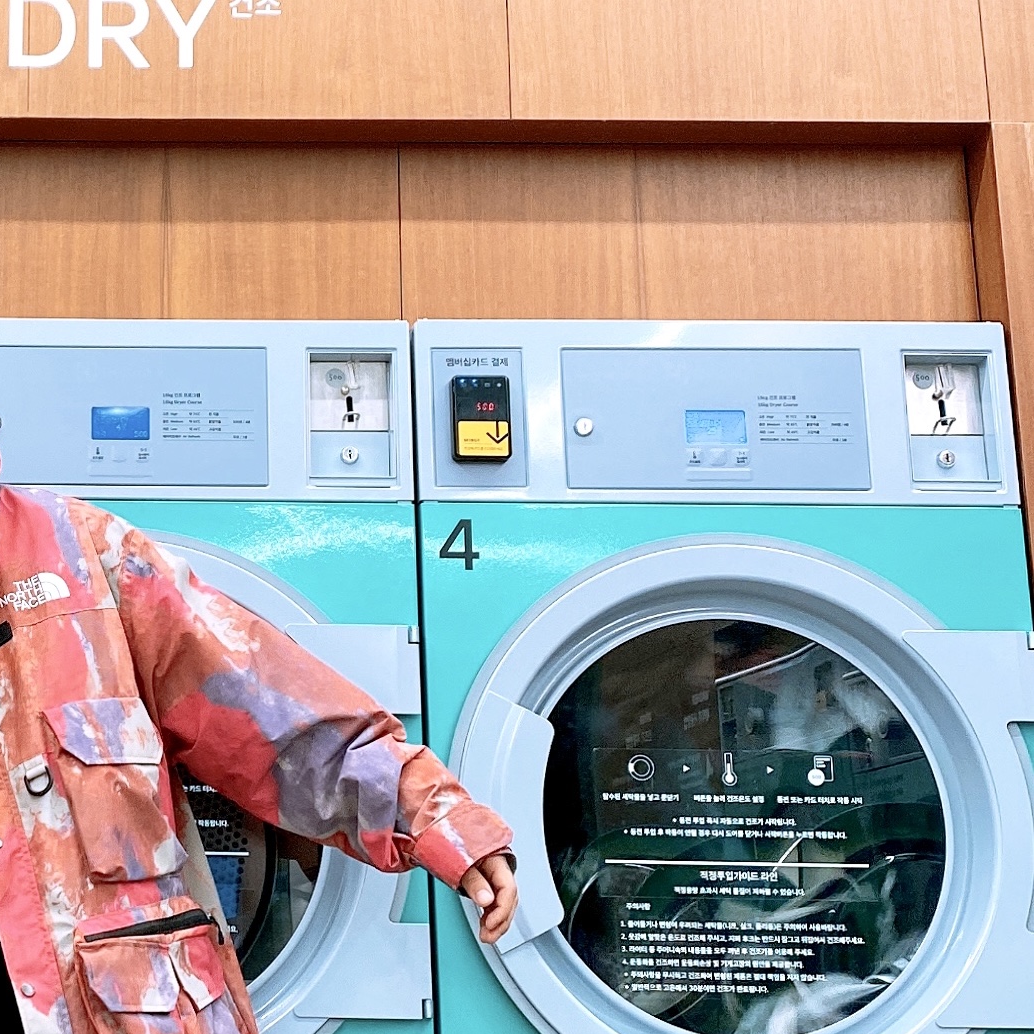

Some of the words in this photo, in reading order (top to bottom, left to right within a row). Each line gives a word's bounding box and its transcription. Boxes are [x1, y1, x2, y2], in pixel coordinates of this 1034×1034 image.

[8, 0, 215, 69] DRY
[446, 358, 488, 366] 멤버십카드
[492, 358, 509, 366] 결제
[477, 402, 495, 411] 500
[438, 518, 480, 572] 4
[13, 574, 38, 592] THE
[13, 593, 46, 612] FACE
[700, 871, 759, 881] 적정투입가이드
[761, 872, 778, 881] 라인
